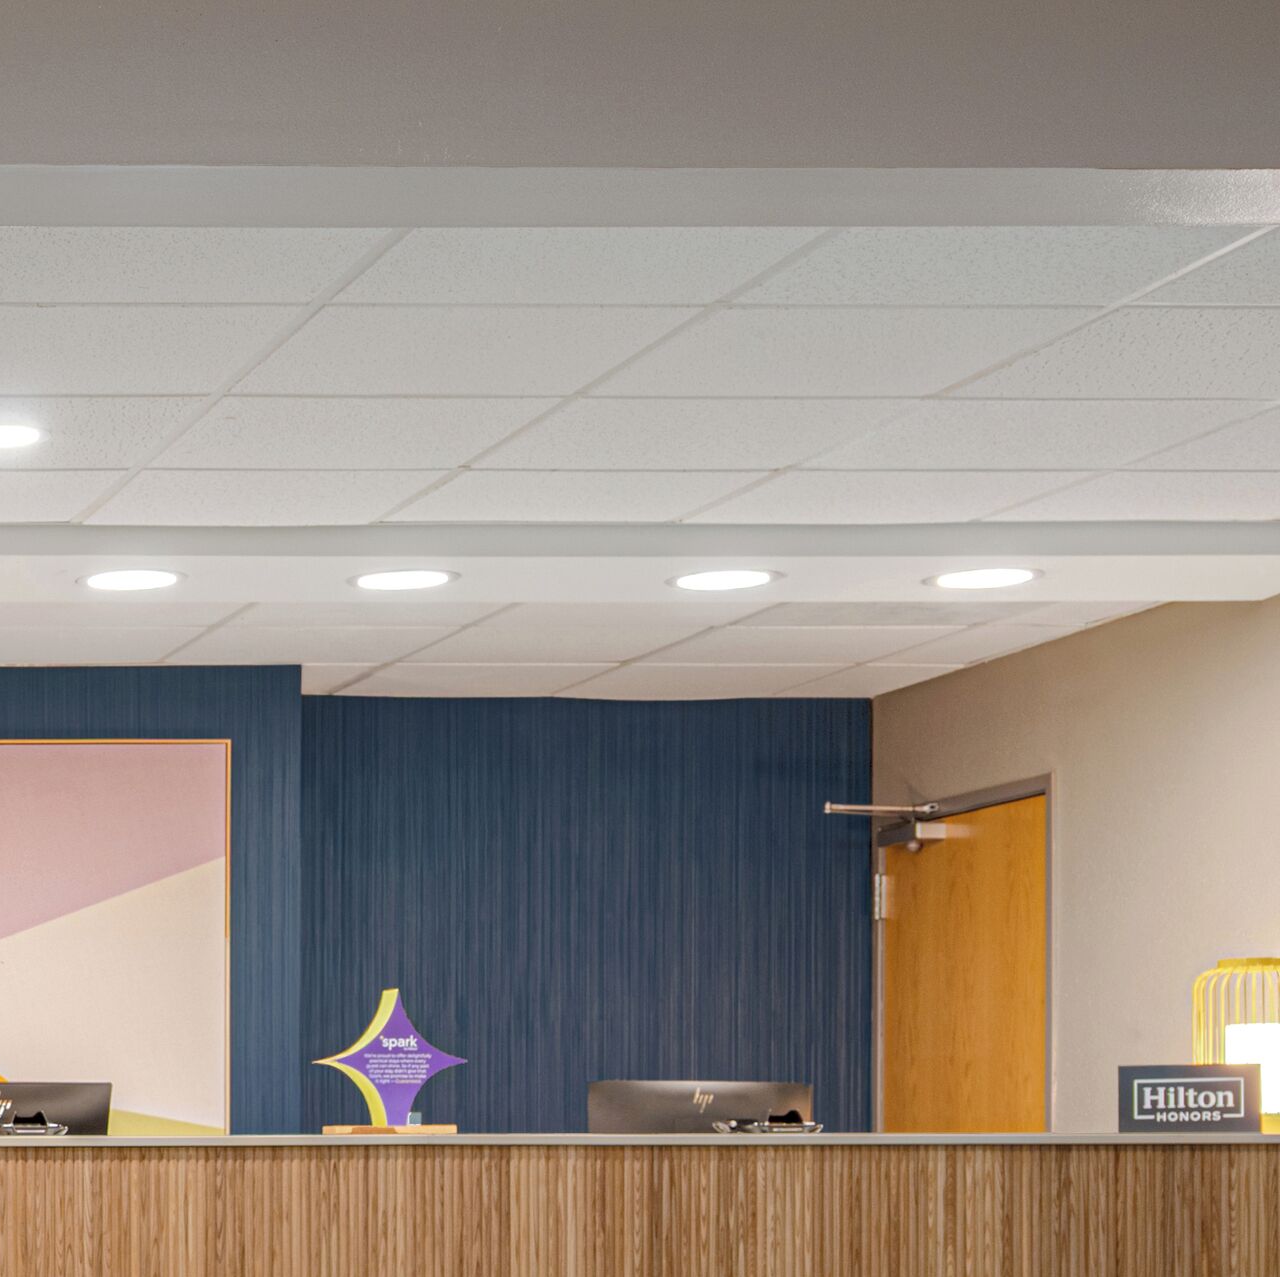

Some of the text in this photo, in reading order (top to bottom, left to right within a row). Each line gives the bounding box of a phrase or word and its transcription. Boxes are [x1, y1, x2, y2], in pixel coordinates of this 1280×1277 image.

[382, 1034, 418, 1051] spark
[1142, 1085, 1236, 1109] Hilton
[1156, 1110, 1222, 1122] HONORS
